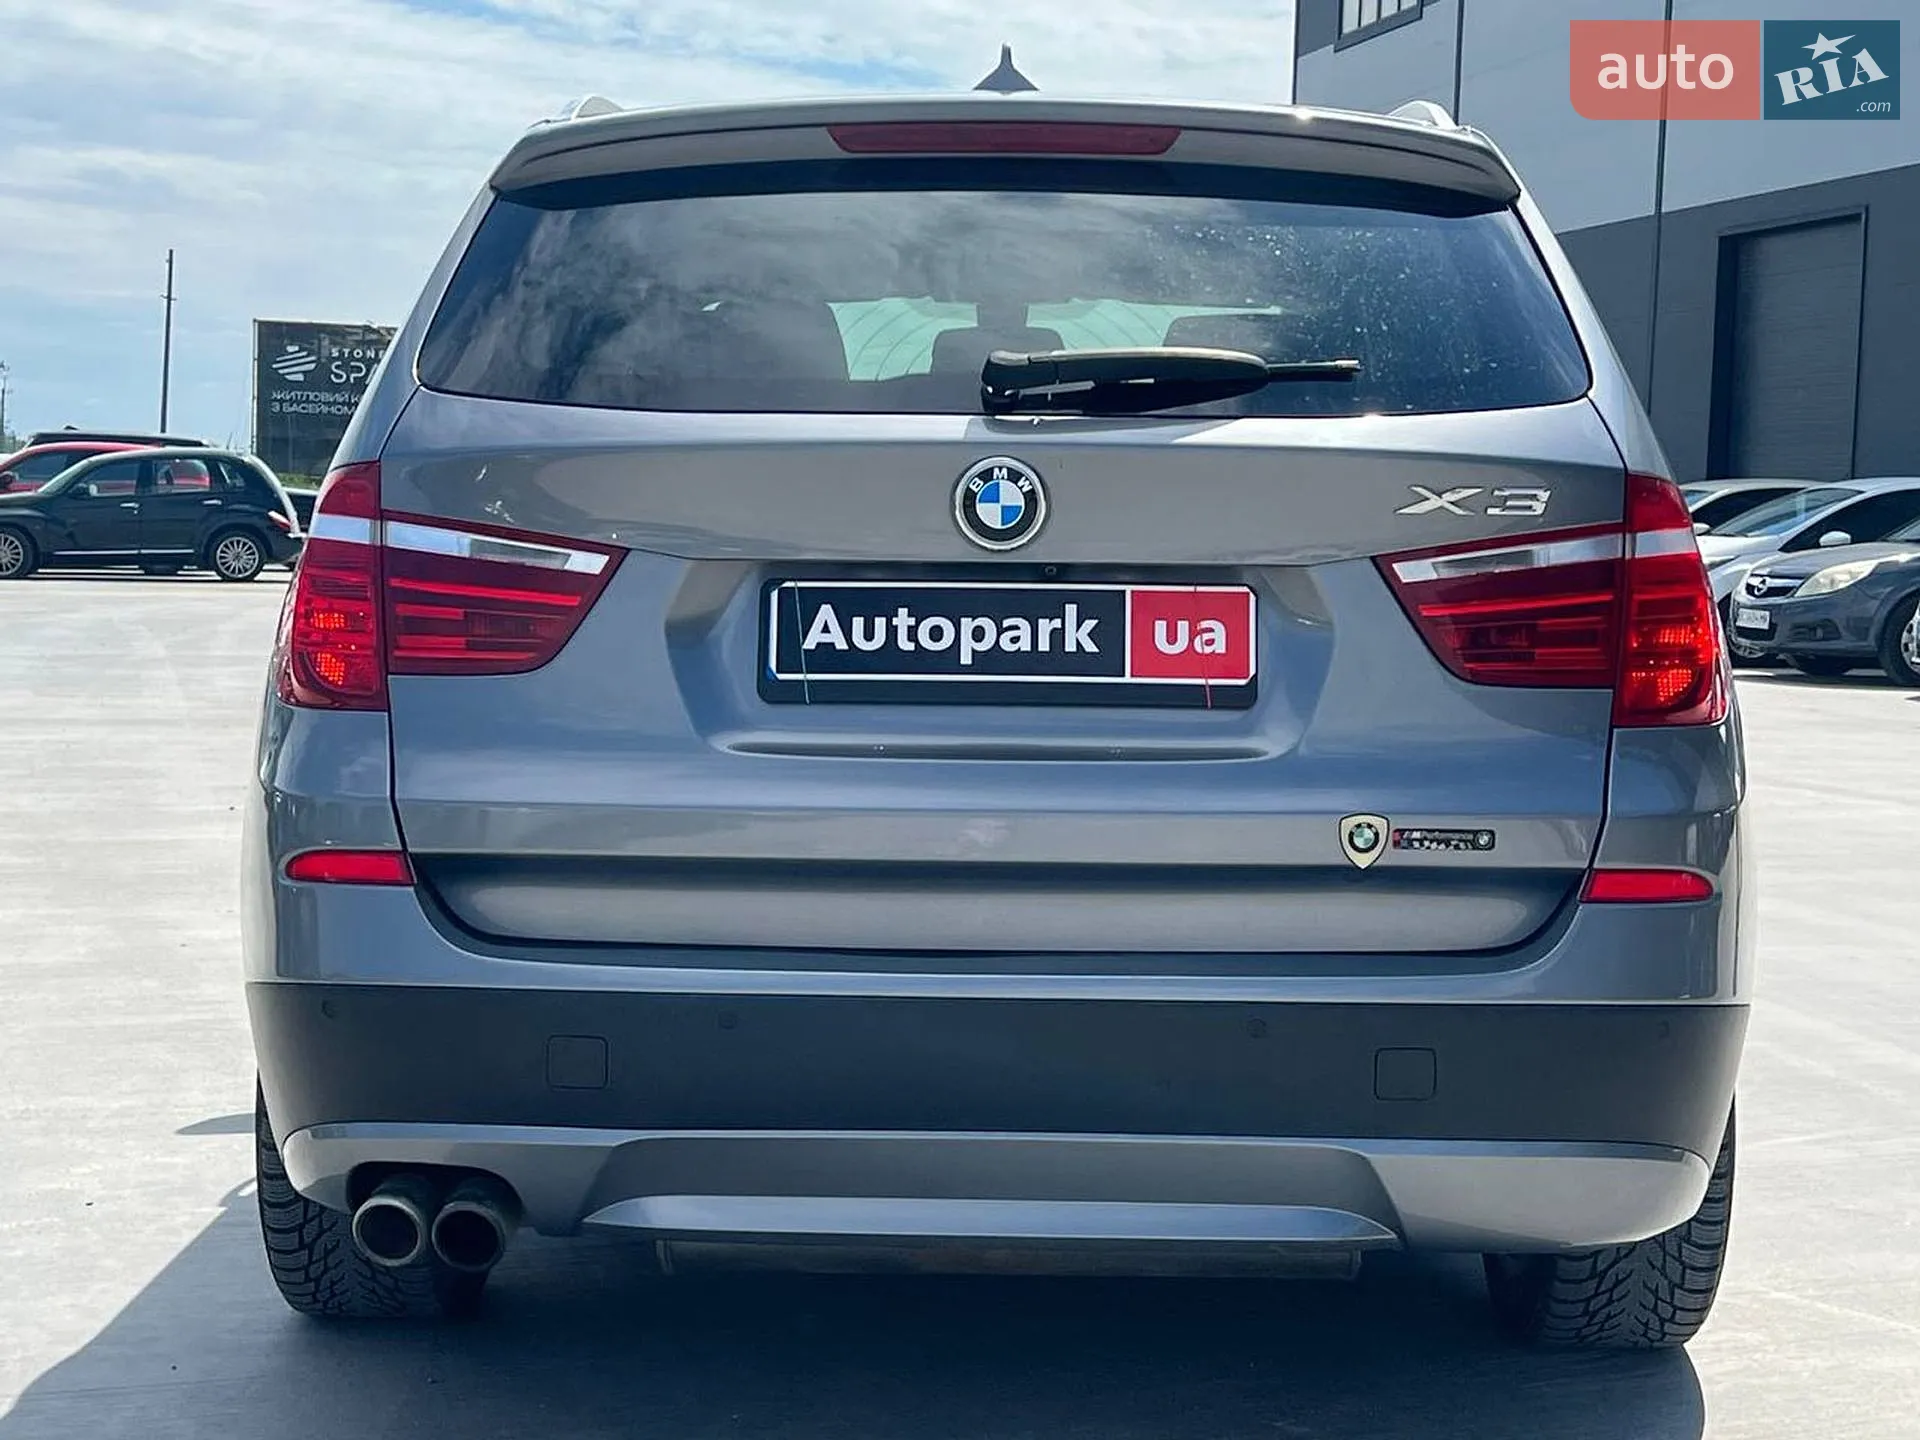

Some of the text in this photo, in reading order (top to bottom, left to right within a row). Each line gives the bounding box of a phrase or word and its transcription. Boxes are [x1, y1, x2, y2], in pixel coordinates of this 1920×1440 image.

[968, 467, 1033, 493] BMW
[1394, 484, 1551, 516] X3
[802, 604, 1227, 664] Autopark ua
